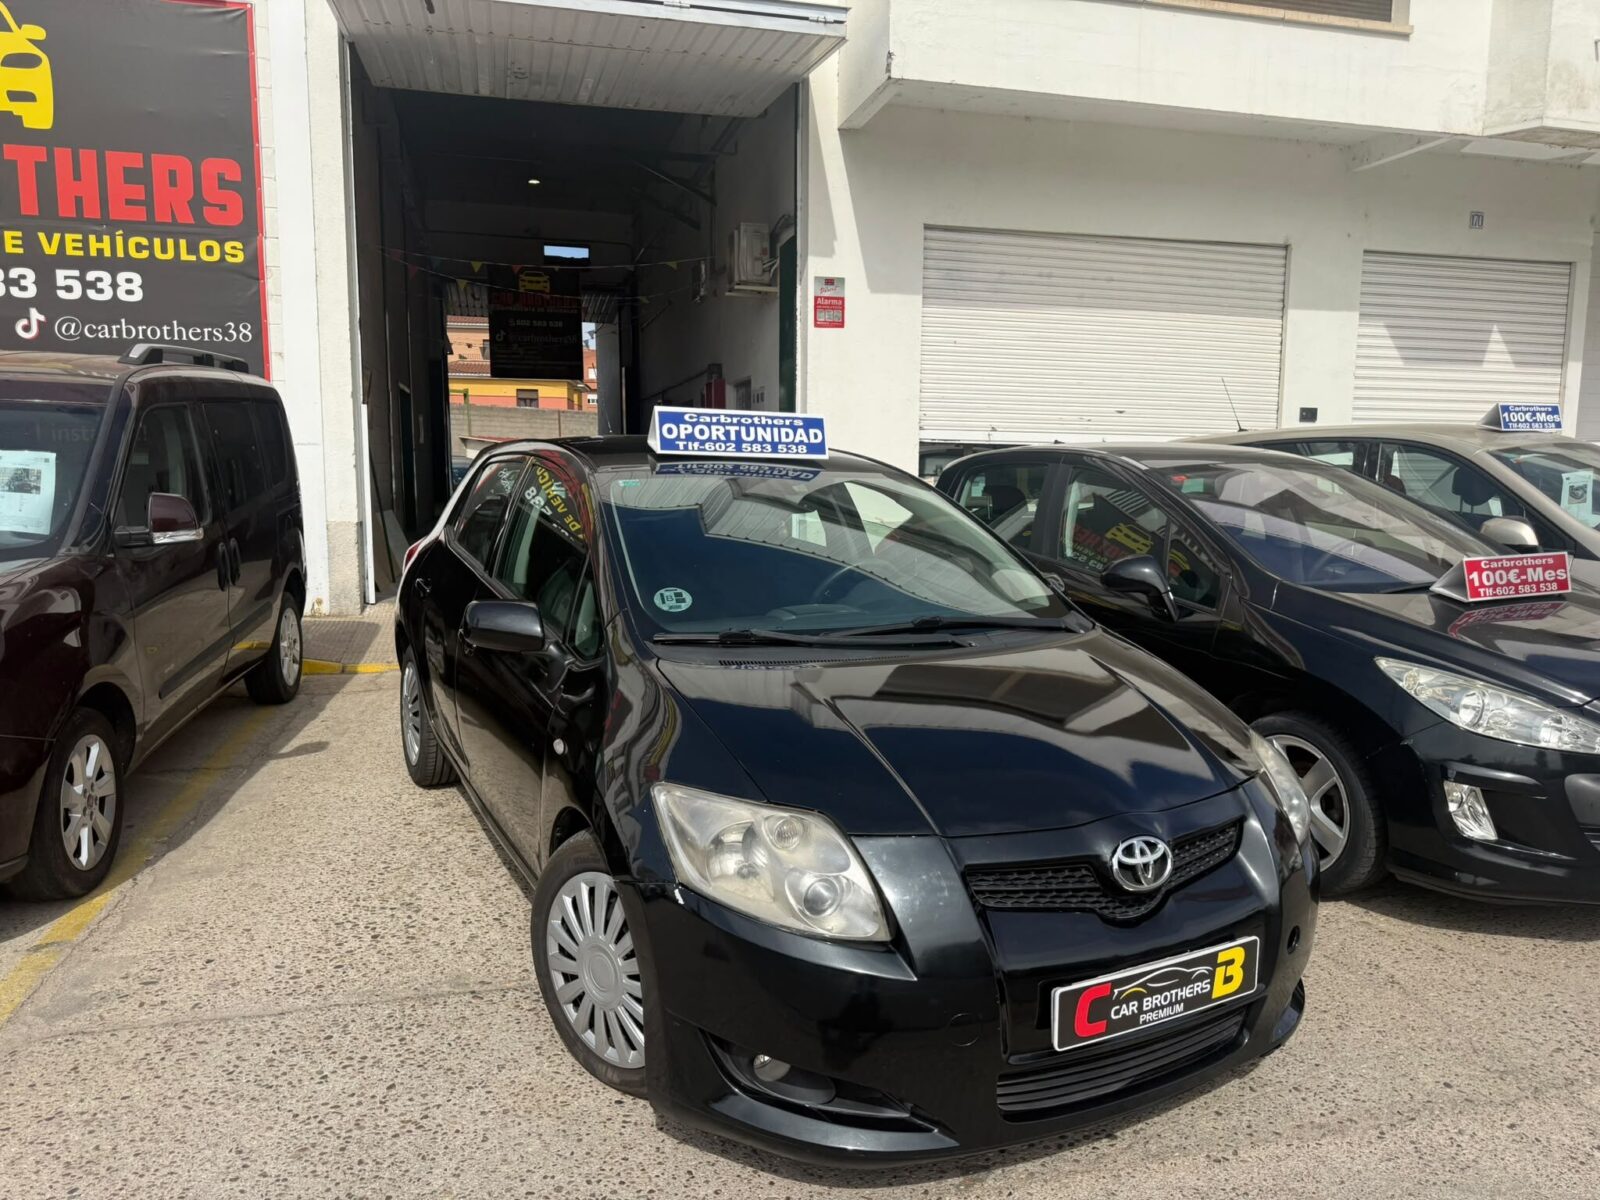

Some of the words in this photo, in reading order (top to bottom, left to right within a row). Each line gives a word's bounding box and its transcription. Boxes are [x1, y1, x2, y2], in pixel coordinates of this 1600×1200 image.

[3, 144, 244, 226] THERS
[37, 230, 245, 263] VEHÍCULOS
[0, 267, 38, 299] 3
[55, 268, 144, 302] 538
[816, 297, 843, 305] Alarma
[54, 316, 253, 342] @carbrothers38
[683, 413, 804, 426] Carbrothers
[1503, 411, 1560, 422] 100€-Mes
[661, 423, 823, 444] OPORTUNIDAD
[676, 441, 736, 452] Tlf-602
[741, 442, 773, 453] 583
[777, 443, 808, 454] 538
[1481, 557, 1554, 569] Carbrothers
[1469, 567, 1567, 587] 100€-Mes
[1478, 586, 1515, 597] Tlf-602
[1518, 584, 1537, 593] 583
[1539, 582, 1558, 592] 538
[1110, 1001, 1138, 1020] CAR
[1143, 979, 1211, 1011] BROTHERS
[1139, 1002, 1184, 1025] PREMIUM
